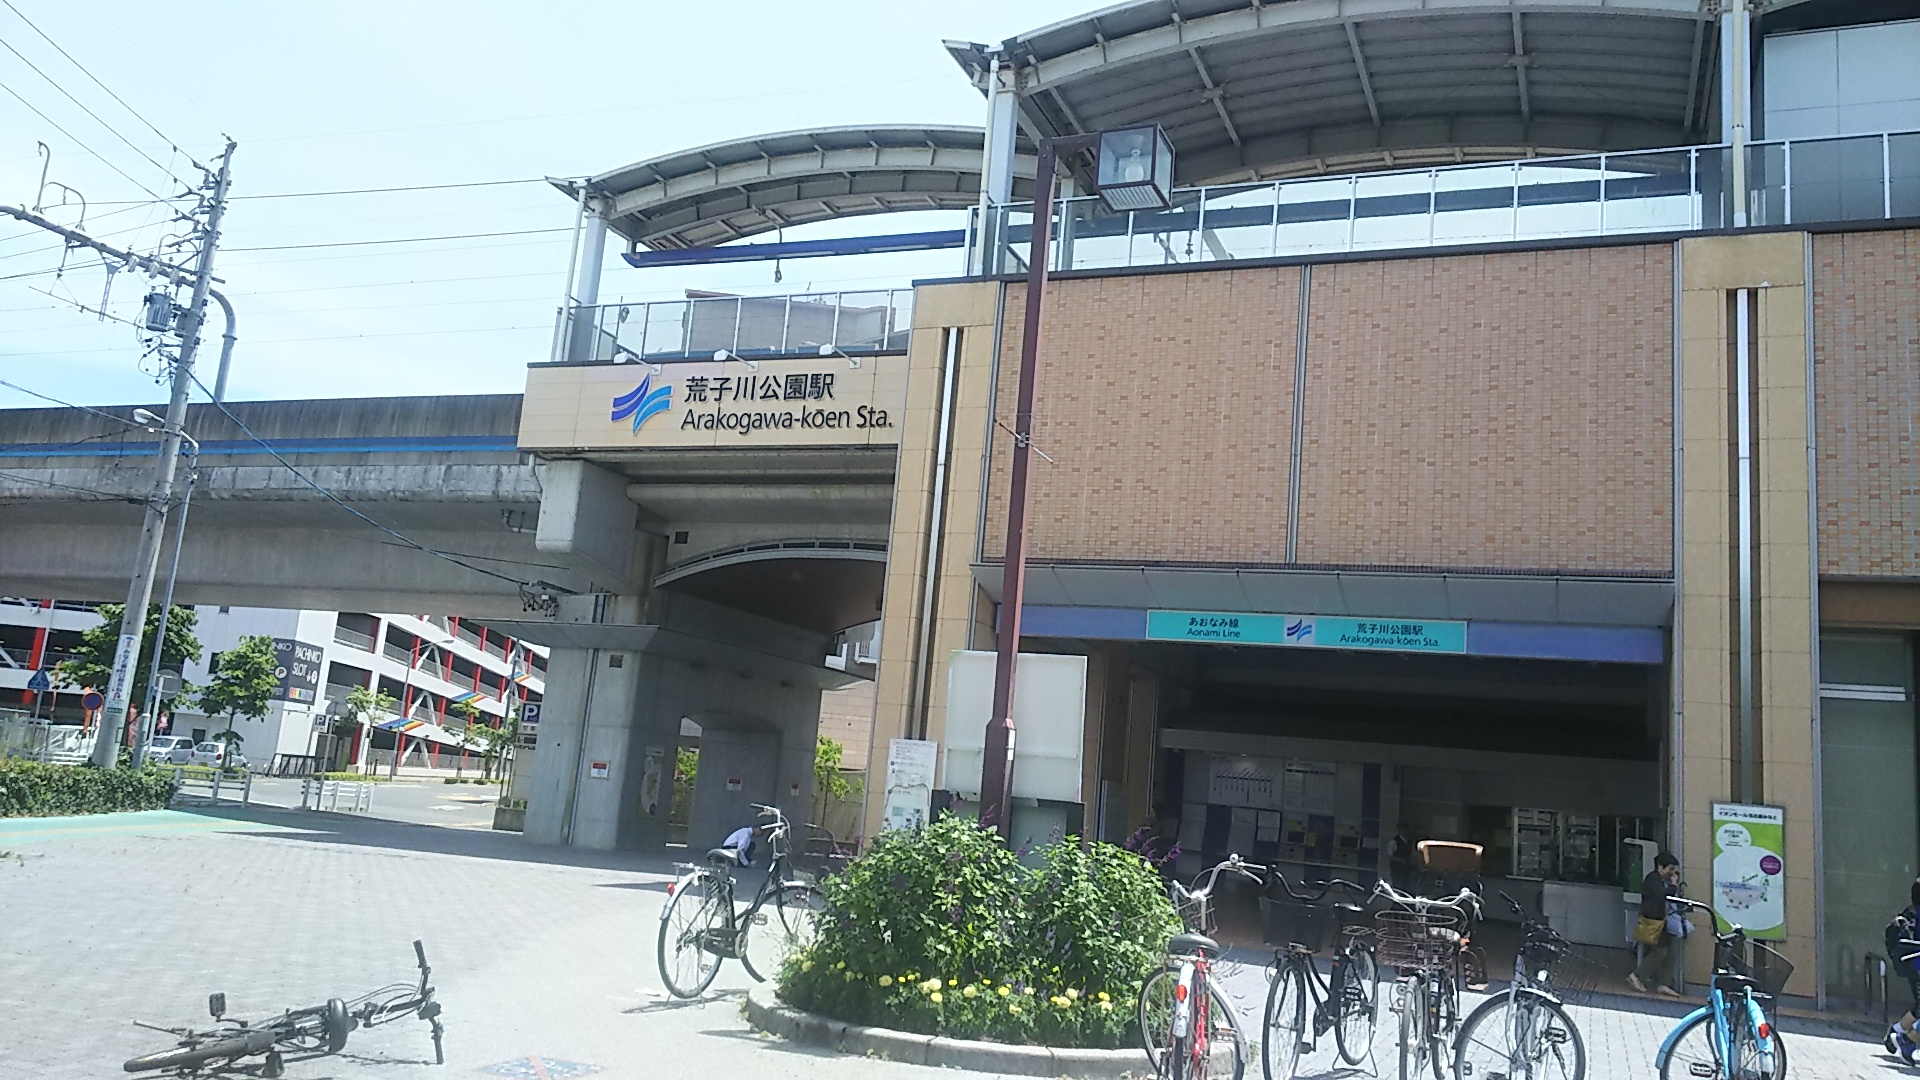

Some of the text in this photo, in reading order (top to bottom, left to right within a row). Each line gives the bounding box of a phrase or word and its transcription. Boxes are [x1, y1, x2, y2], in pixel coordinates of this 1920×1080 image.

[685, 373, 834, 402] 荒子川公園駅
[681, 405, 893, 434] Arakogawa-kōen Sta.
[1189, 617, 1239, 628] あおなみ線
[1187, 628, 1241, 638] Aonami Line
[1357, 623, 1424, 636] 荒子川公園駅
[524, 705, 538, 720] P
[317, 716, 324, 725] P
